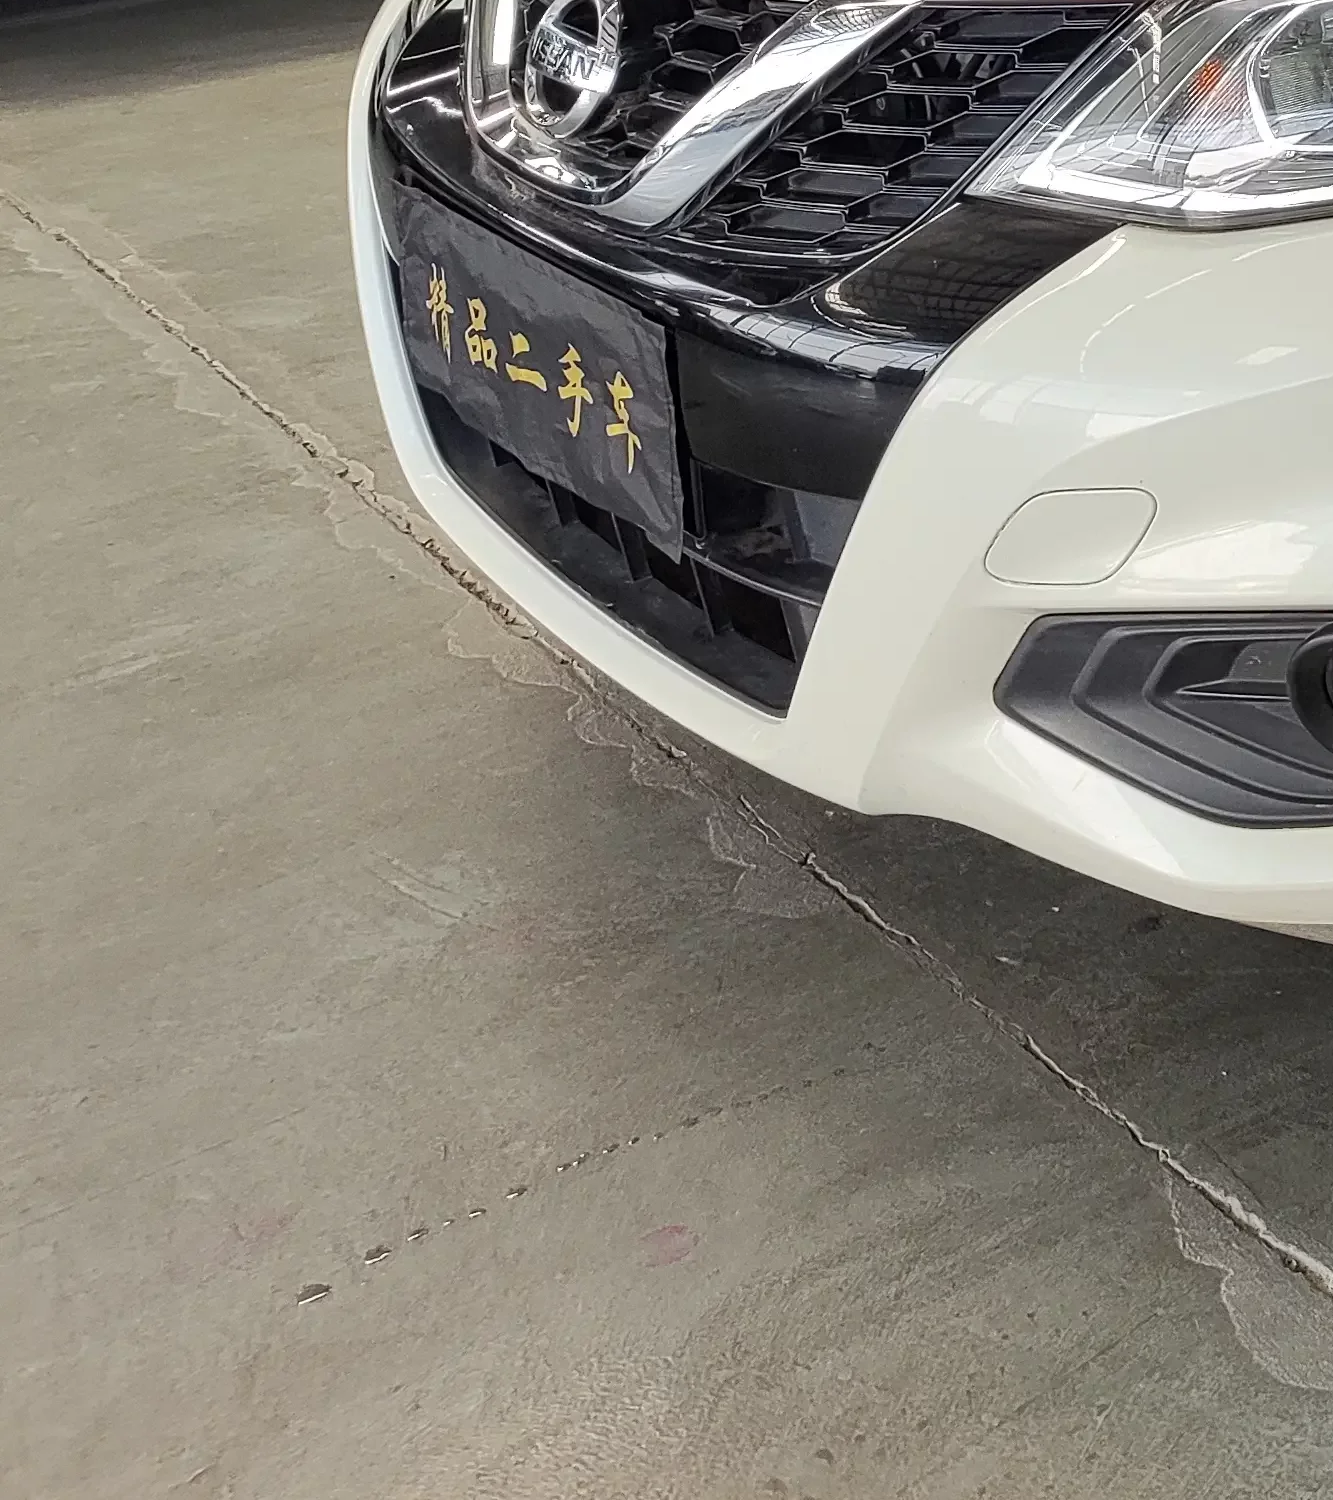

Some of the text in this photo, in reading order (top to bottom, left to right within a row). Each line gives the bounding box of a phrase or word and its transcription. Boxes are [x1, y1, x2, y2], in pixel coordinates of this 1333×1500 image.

[425, 261, 643, 475] 精品二手车
